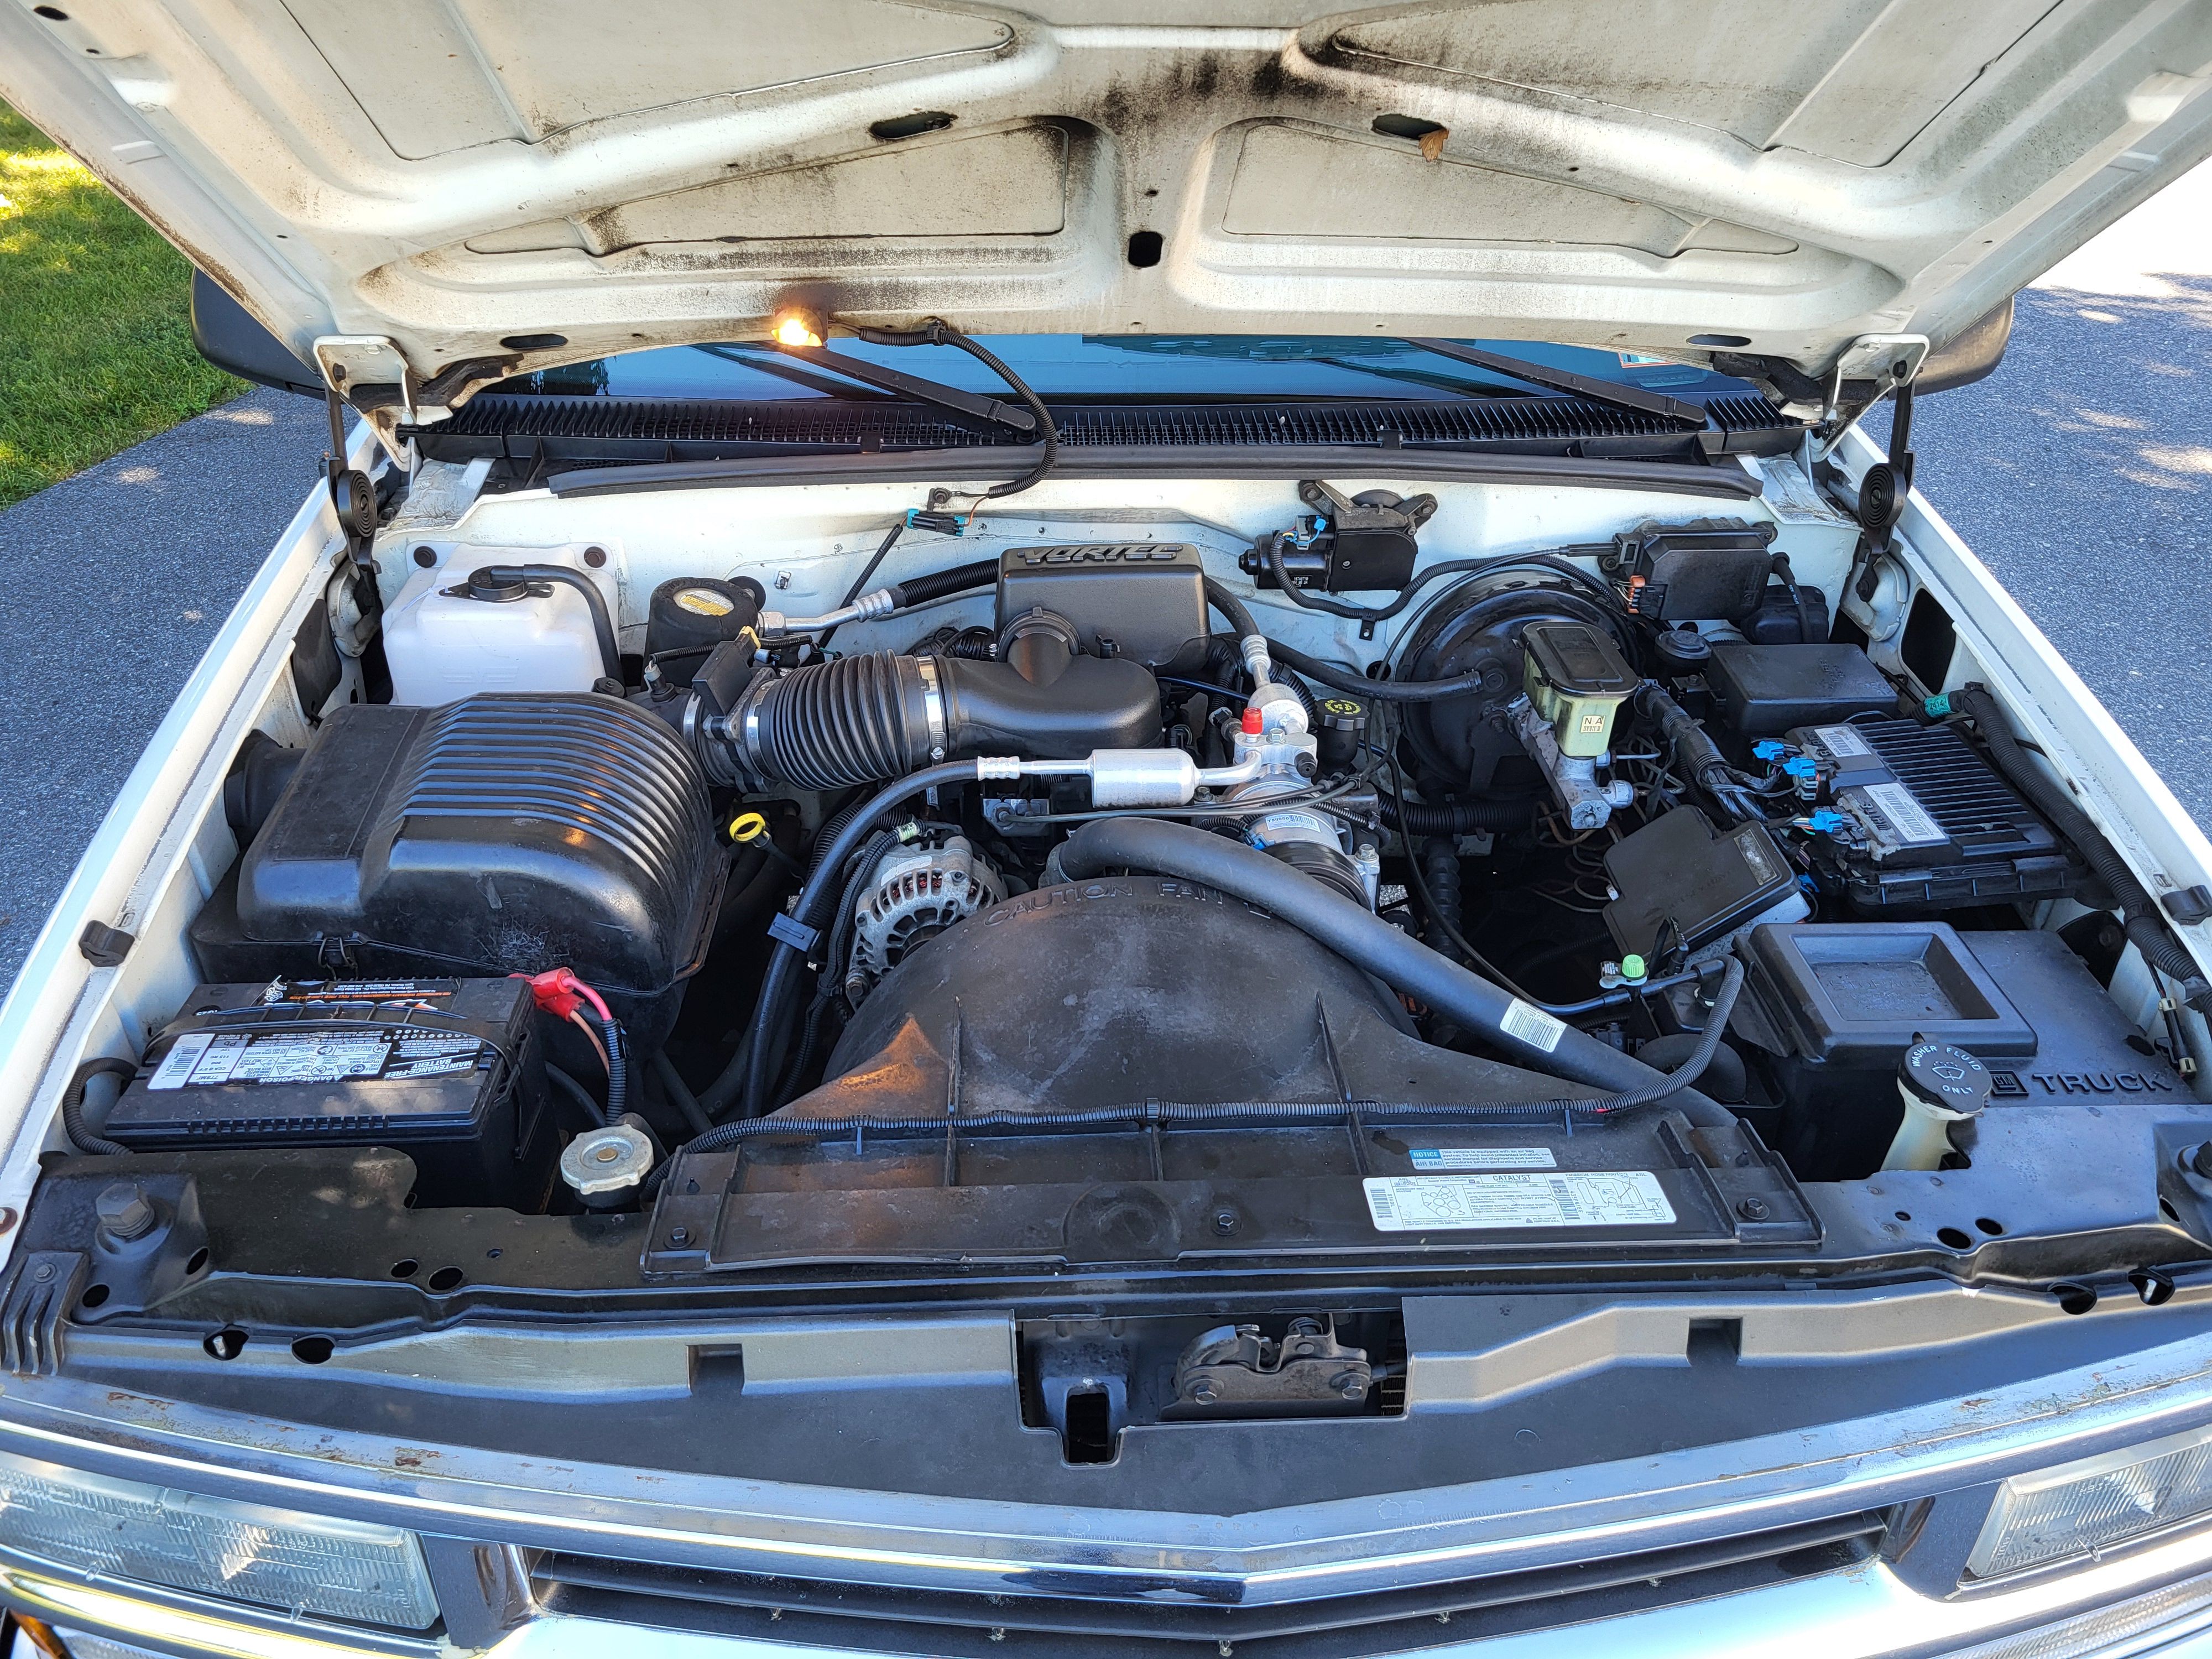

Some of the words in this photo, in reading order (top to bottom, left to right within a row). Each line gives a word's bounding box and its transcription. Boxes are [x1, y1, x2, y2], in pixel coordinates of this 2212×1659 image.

[1018, 544, 1183, 563] VORTEC
[984, 883, 1133, 927] CAUTION
[1157, 883, 1224, 905] FAN
[411, 1058, 452, 1069] BATTERY
[1911, 1045, 1937, 1067] WASHER
[1945, 1047, 1981, 1071] FLUID
[384, 1060, 474, 1078] MAINTENANCE-FREE
[1942, 1084, 1974, 1095] ONLY
[2032, 1072, 2173, 1093] TRUCK
